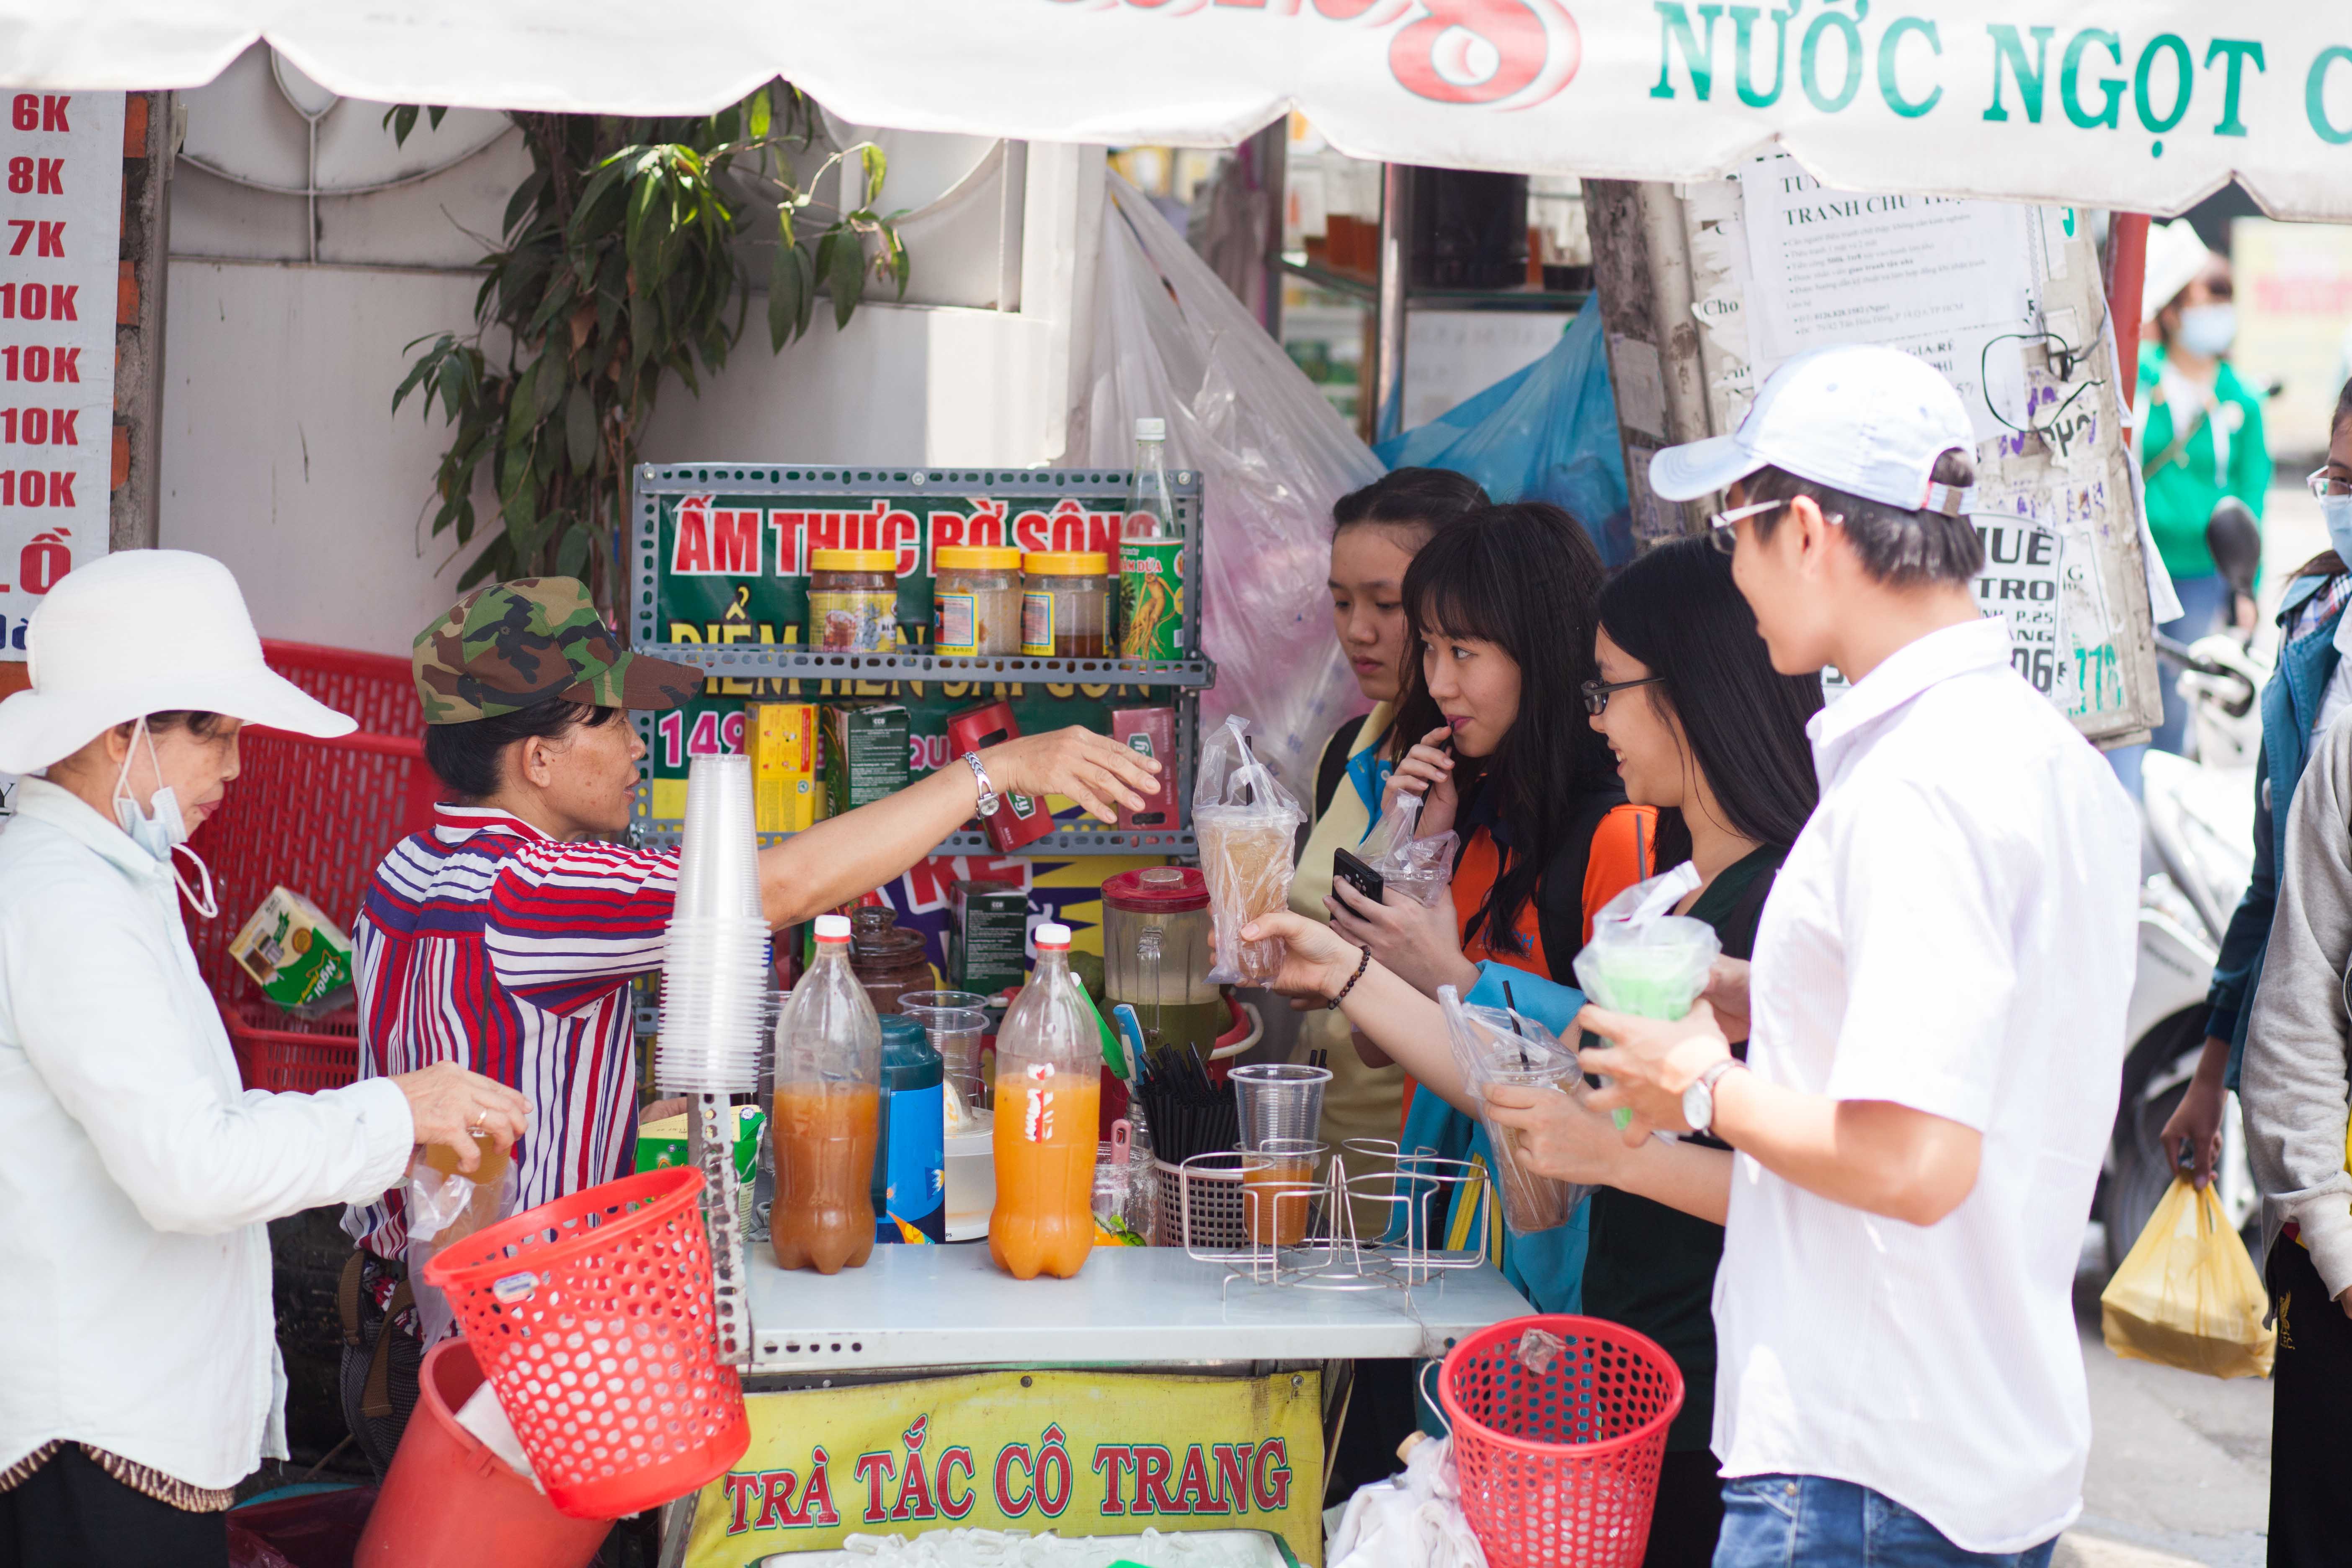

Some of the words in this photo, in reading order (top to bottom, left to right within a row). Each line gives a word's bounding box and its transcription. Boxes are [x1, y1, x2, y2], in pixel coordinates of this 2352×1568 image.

[1982, 23, 2267, 158] NGỌT
[12, 94, 71, 132] 6K
[8, 156, 65, 195] 8K
[1783, 200, 1859, 225] TRANH
[8, 219, 66, 258] 7K
[0, 283, 79, 321] 10K
[1703, 299, 1739, 316] Cho
[1, 345, 81, 383] 10K
[0, 407, 80, 446] 10K
[0, 469, 77, 508] 10K
[2016, 610, 2053, 624] P.25
[724, 1445, 840, 1536] TRÀ
[855, 1413, 975, 1524] TẮC
[993, 1421, 1073, 1519] CÔ
[1092, 1437, 1293, 1516] TRANG
